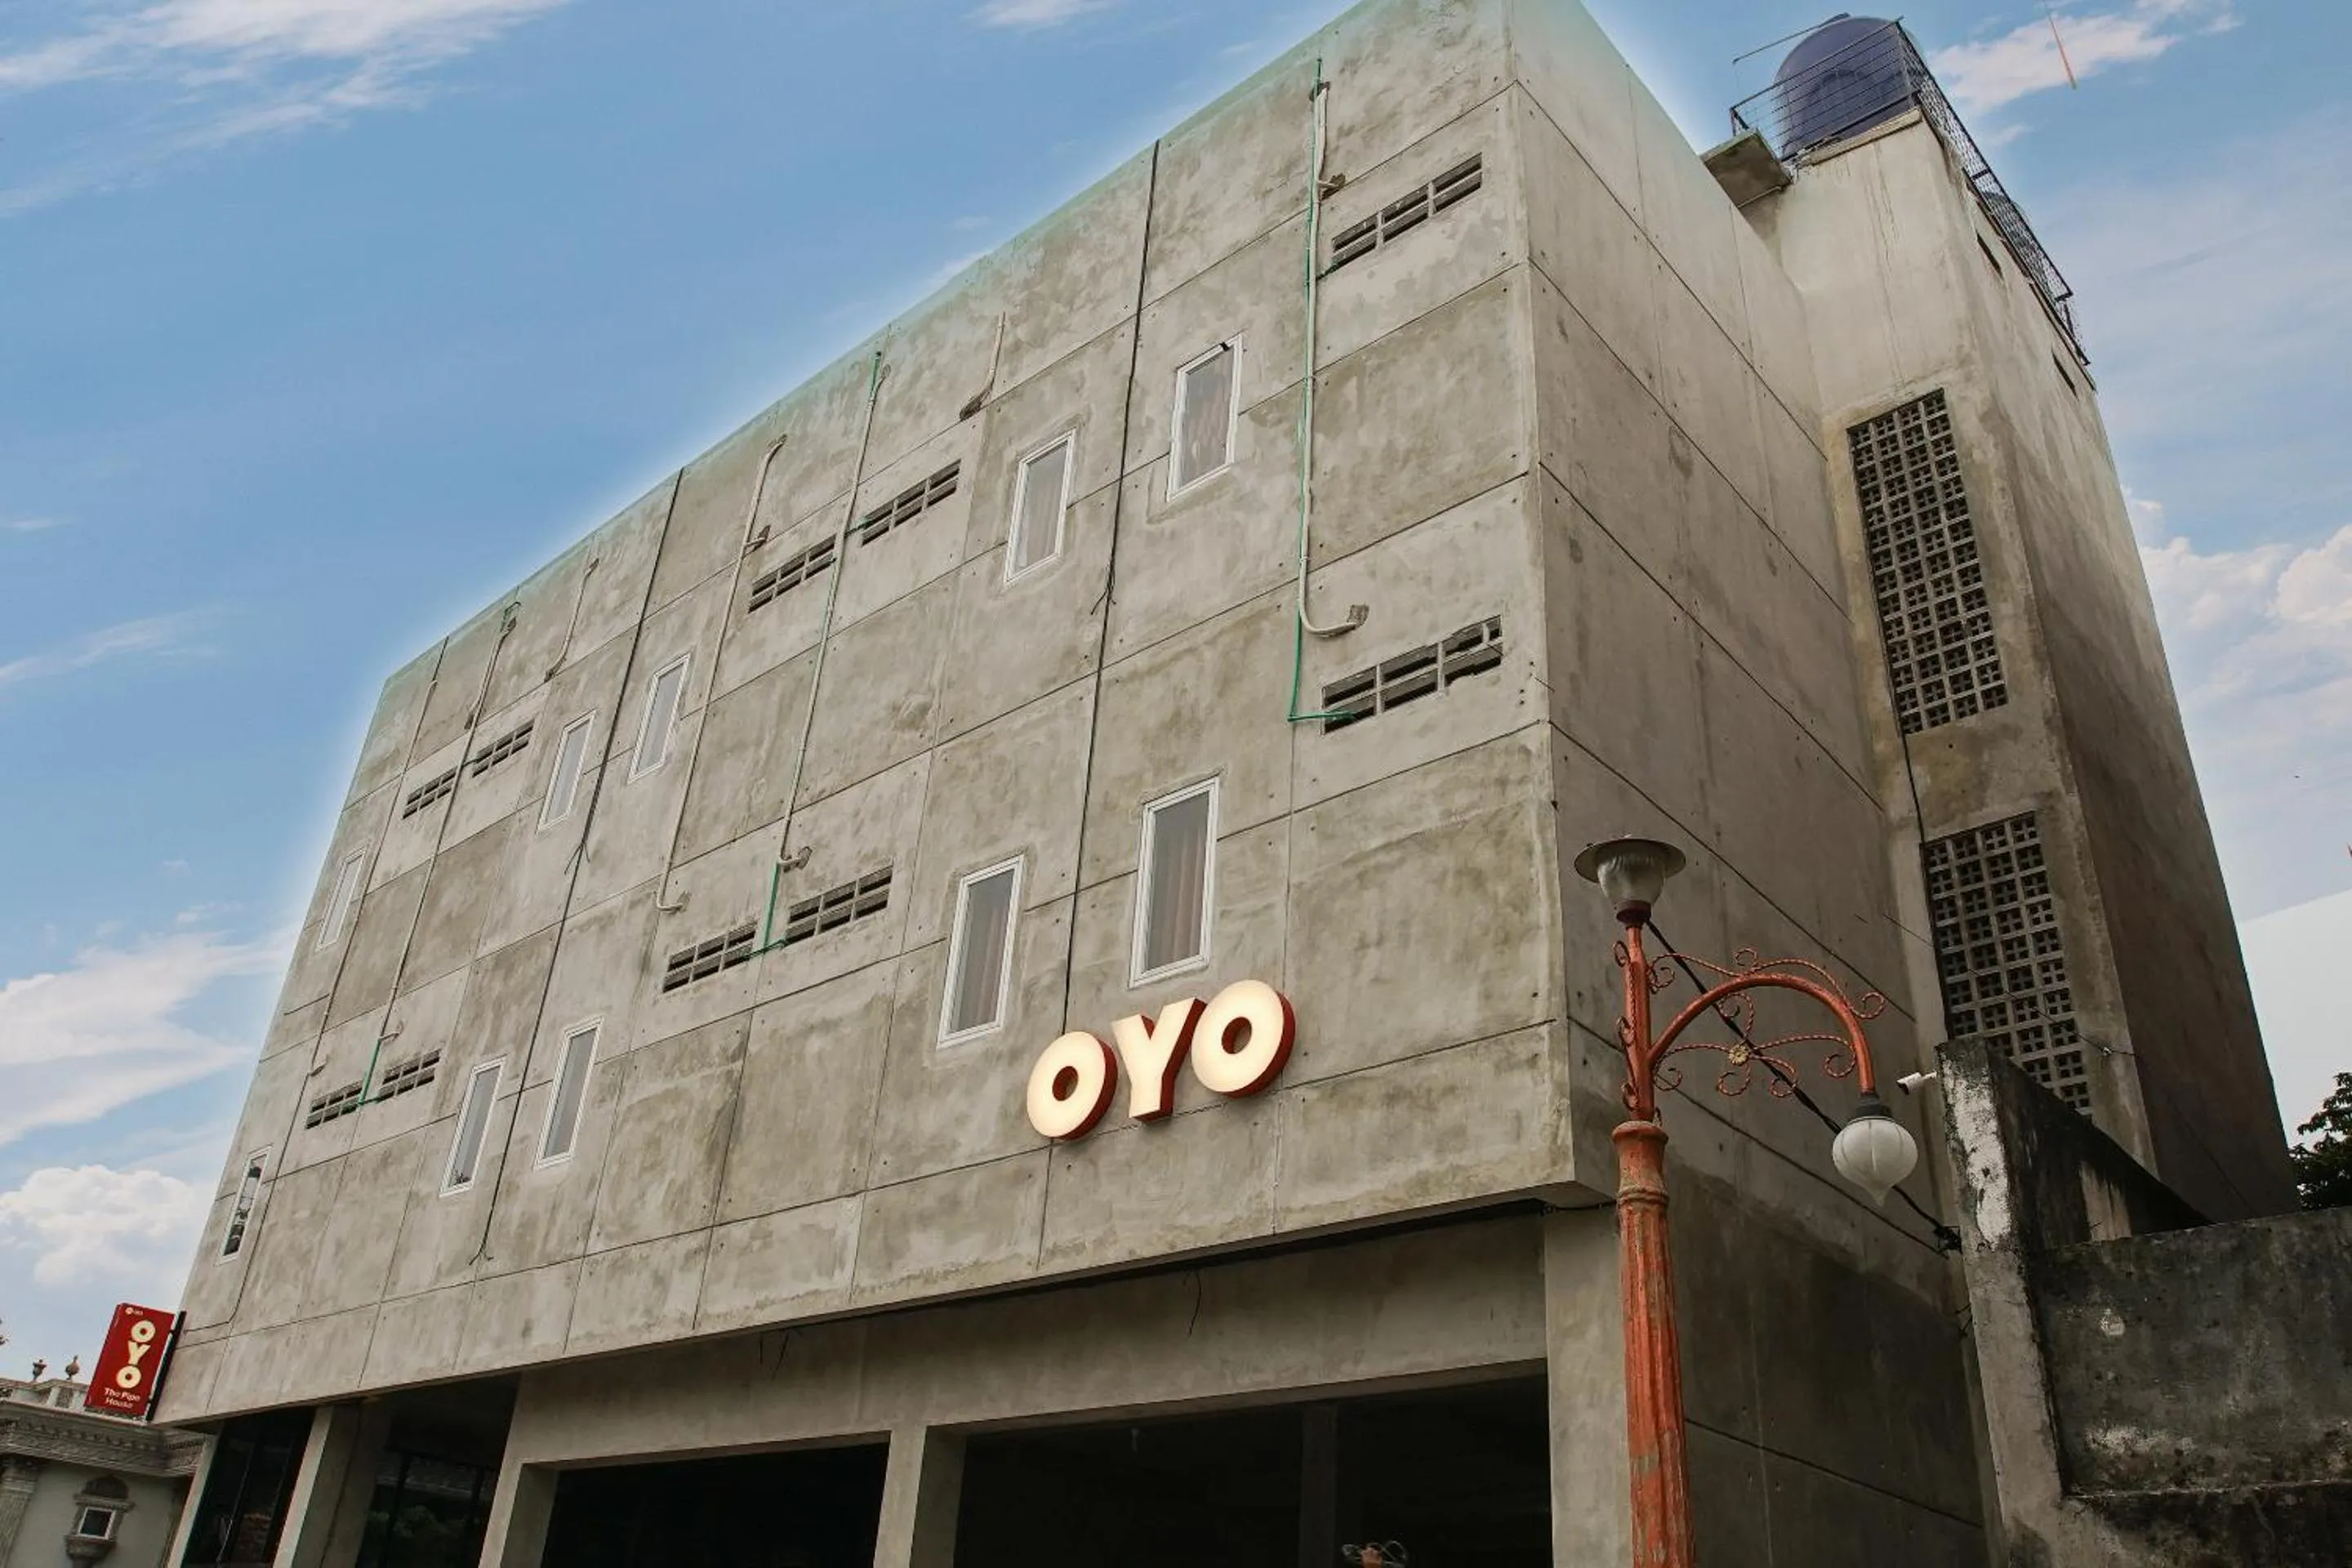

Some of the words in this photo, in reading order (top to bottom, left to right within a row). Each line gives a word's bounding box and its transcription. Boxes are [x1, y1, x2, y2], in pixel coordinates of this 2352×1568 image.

[1027, 979, 1295, 1139] OYO
[115, 1320, 155, 1388] OYO
[105, 1387, 121, 1397] The
[105, 1396, 133, 1408] House
